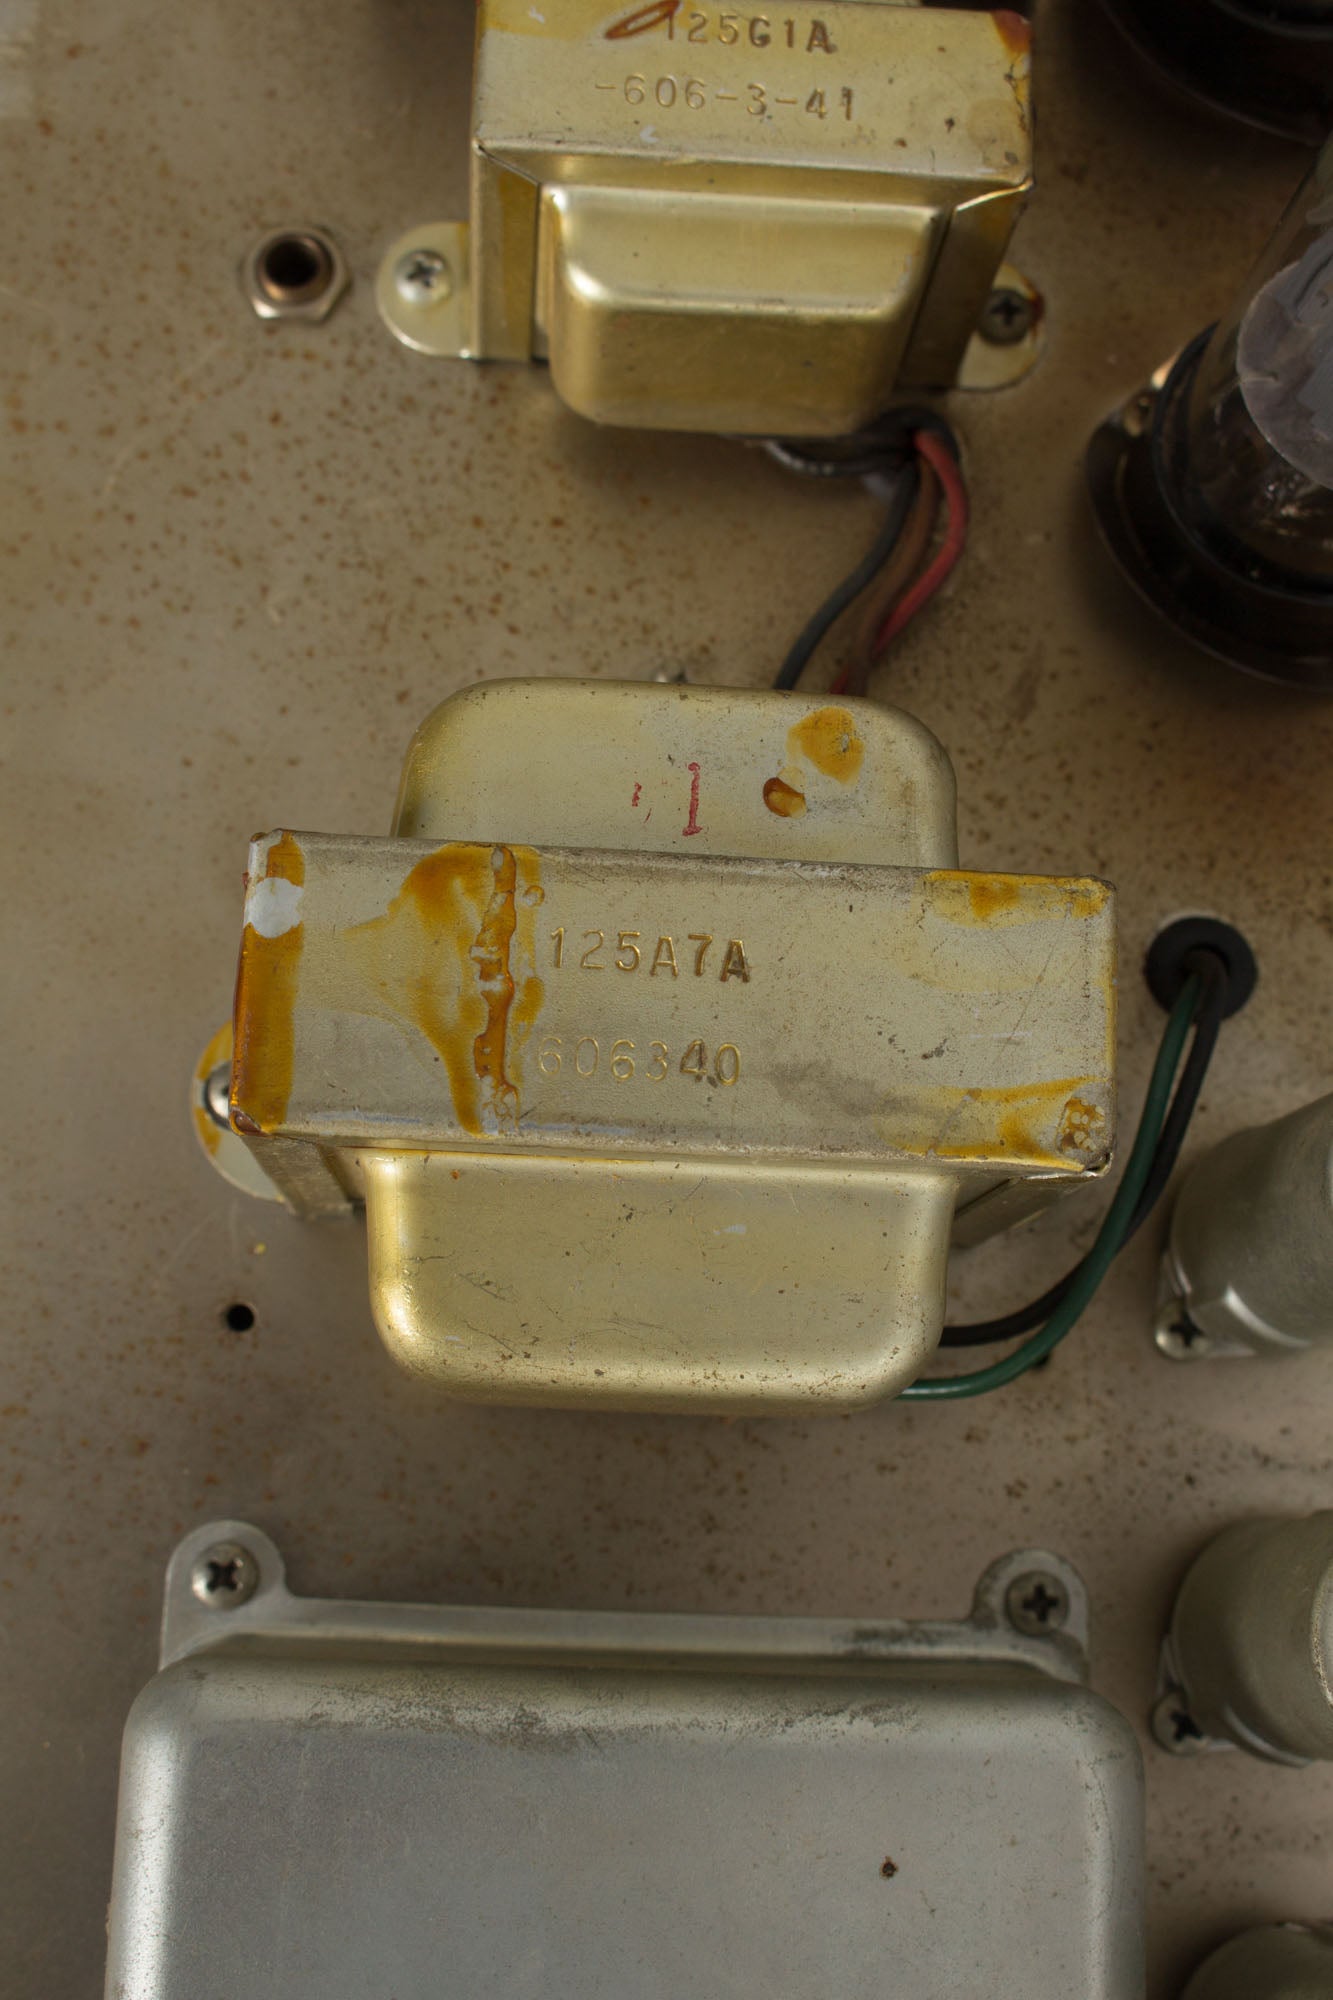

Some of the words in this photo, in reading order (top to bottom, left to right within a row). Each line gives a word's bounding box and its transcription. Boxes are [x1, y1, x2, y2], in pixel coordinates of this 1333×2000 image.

[664, 11, 837, 54] 125G1A
[551, 927, 750, 983] 125A7A
[538, 1036, 741, 1086] 606340
